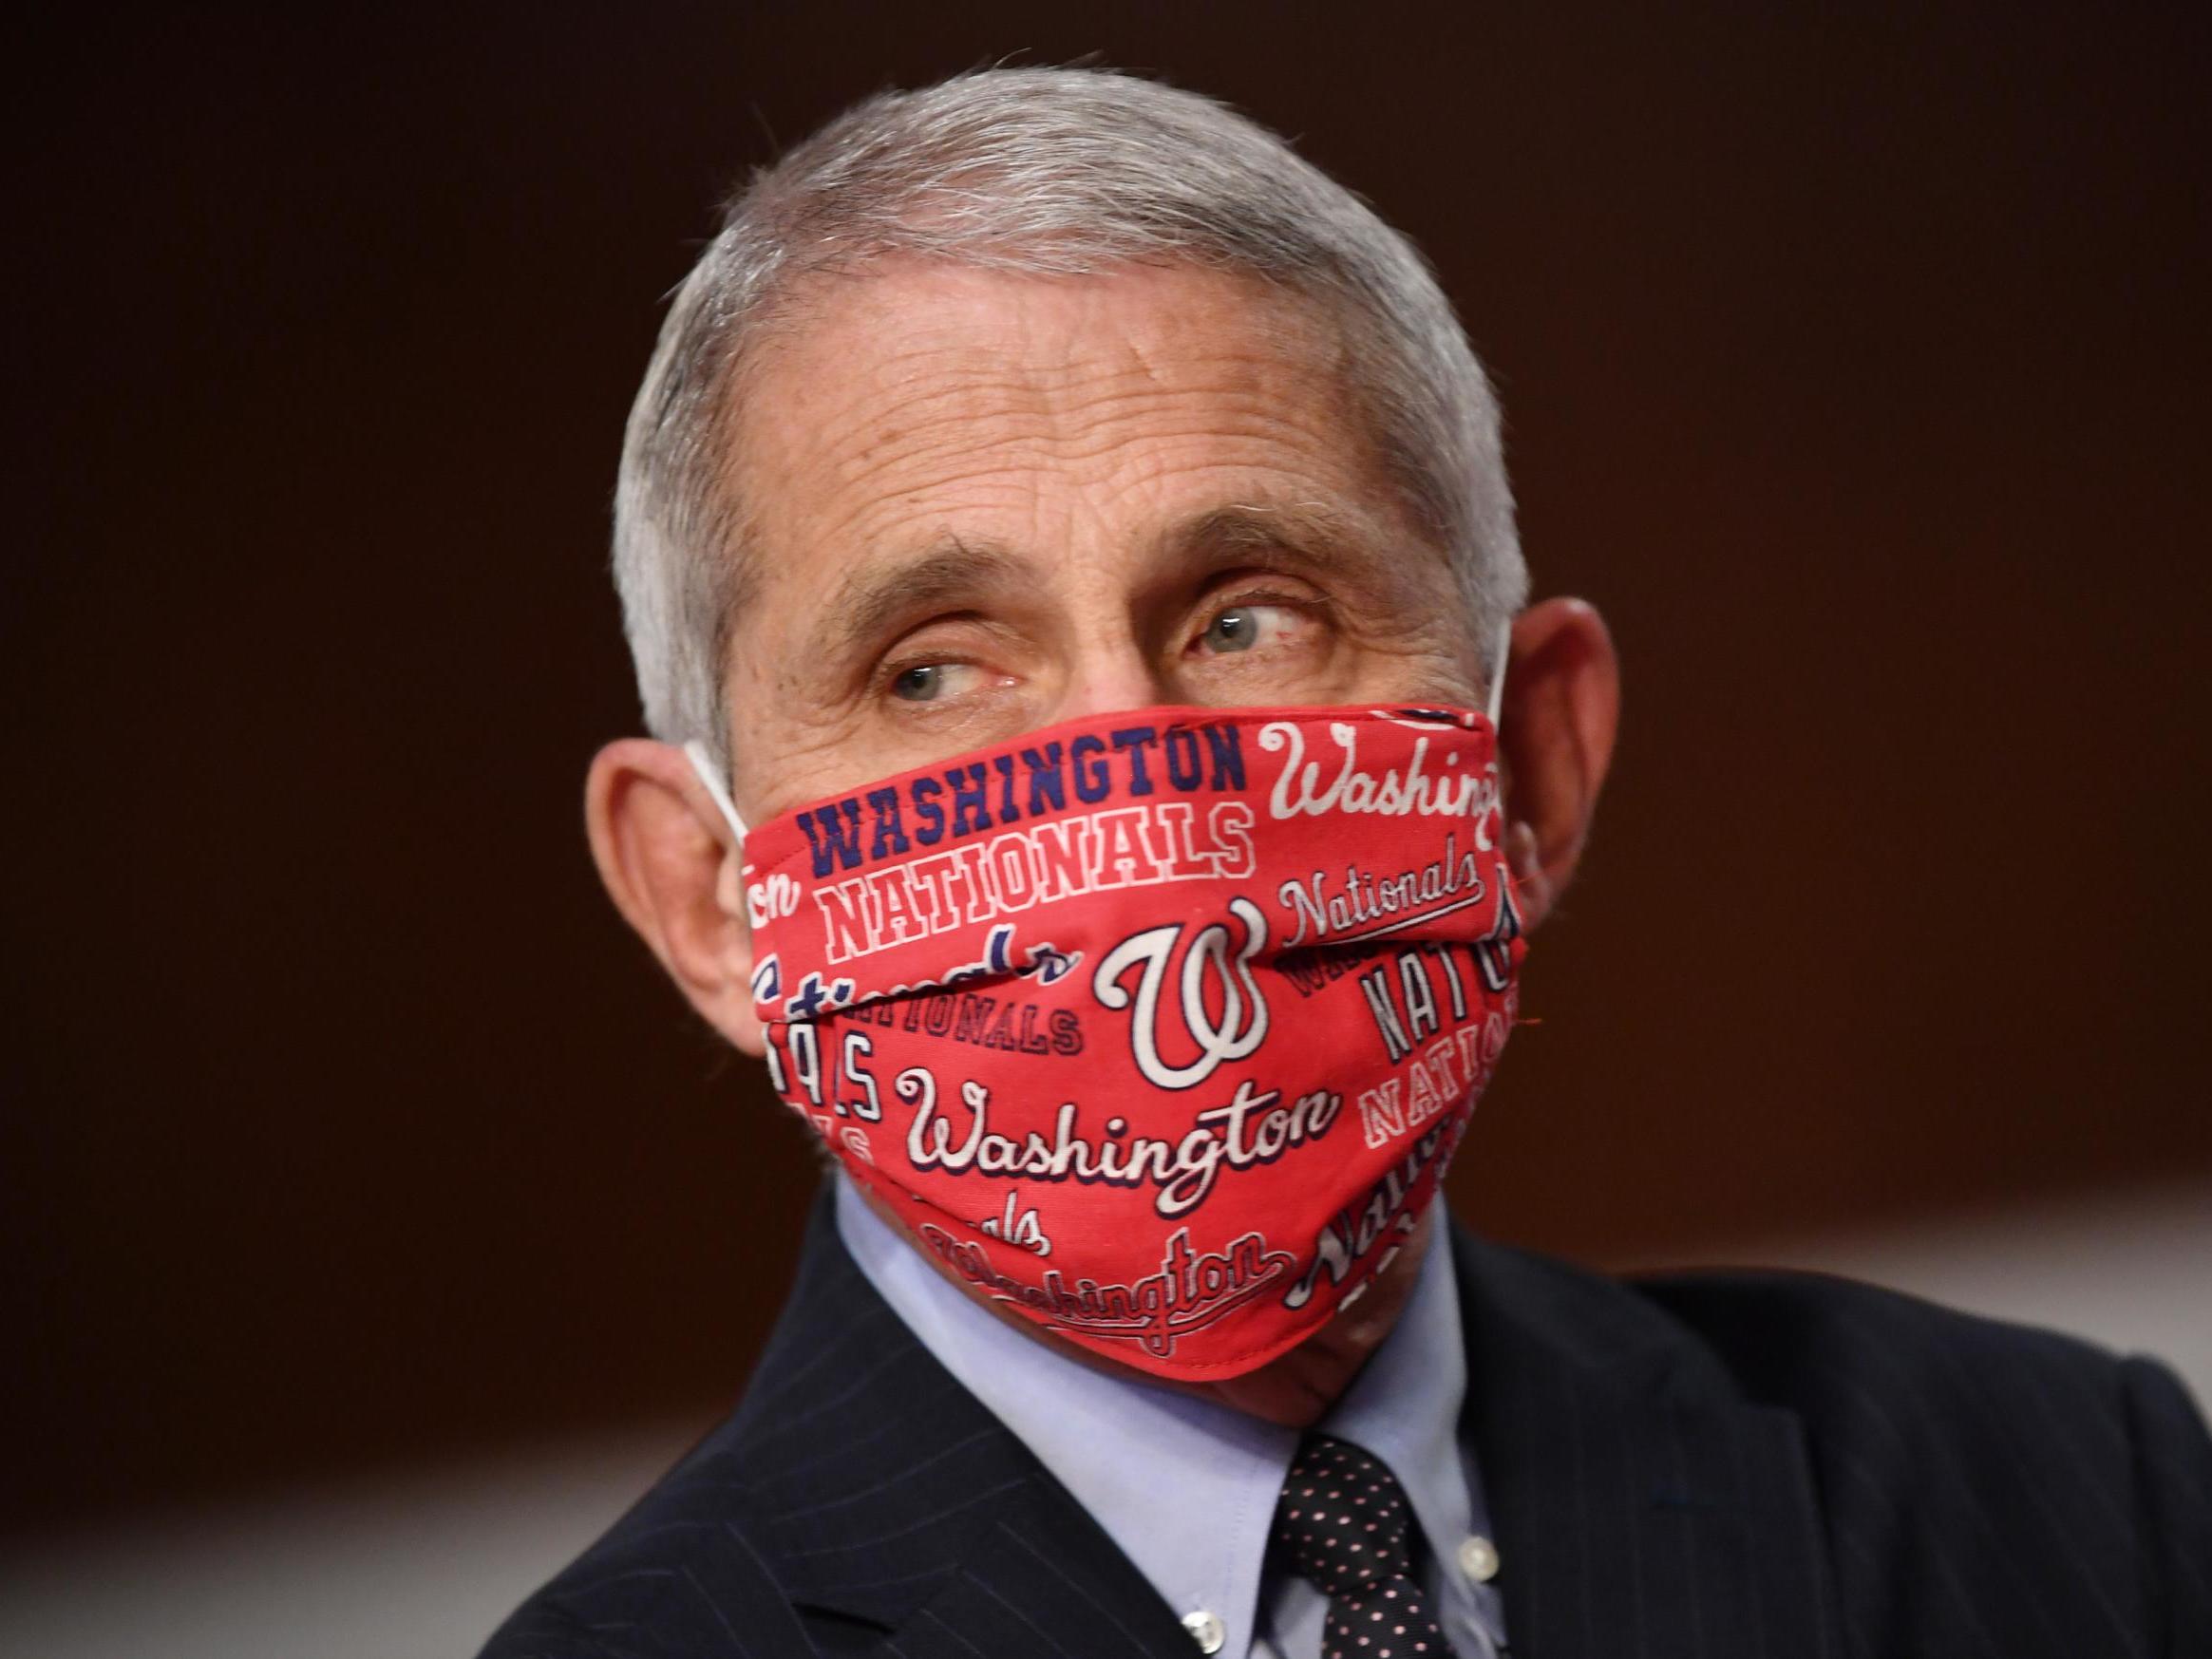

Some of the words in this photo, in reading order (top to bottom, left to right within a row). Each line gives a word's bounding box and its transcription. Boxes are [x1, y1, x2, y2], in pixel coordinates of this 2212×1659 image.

[796, 724, 1247, 879] WASHINGTON
[1258, 721, 1504, 852] Washing
[813, 801, 1256, 966] NATIONALS
[1278, 832, 1488, 949] Nationals
[1092, 895, 1270, 1091] W
[895, 1079, 1344, 1220] Washington
